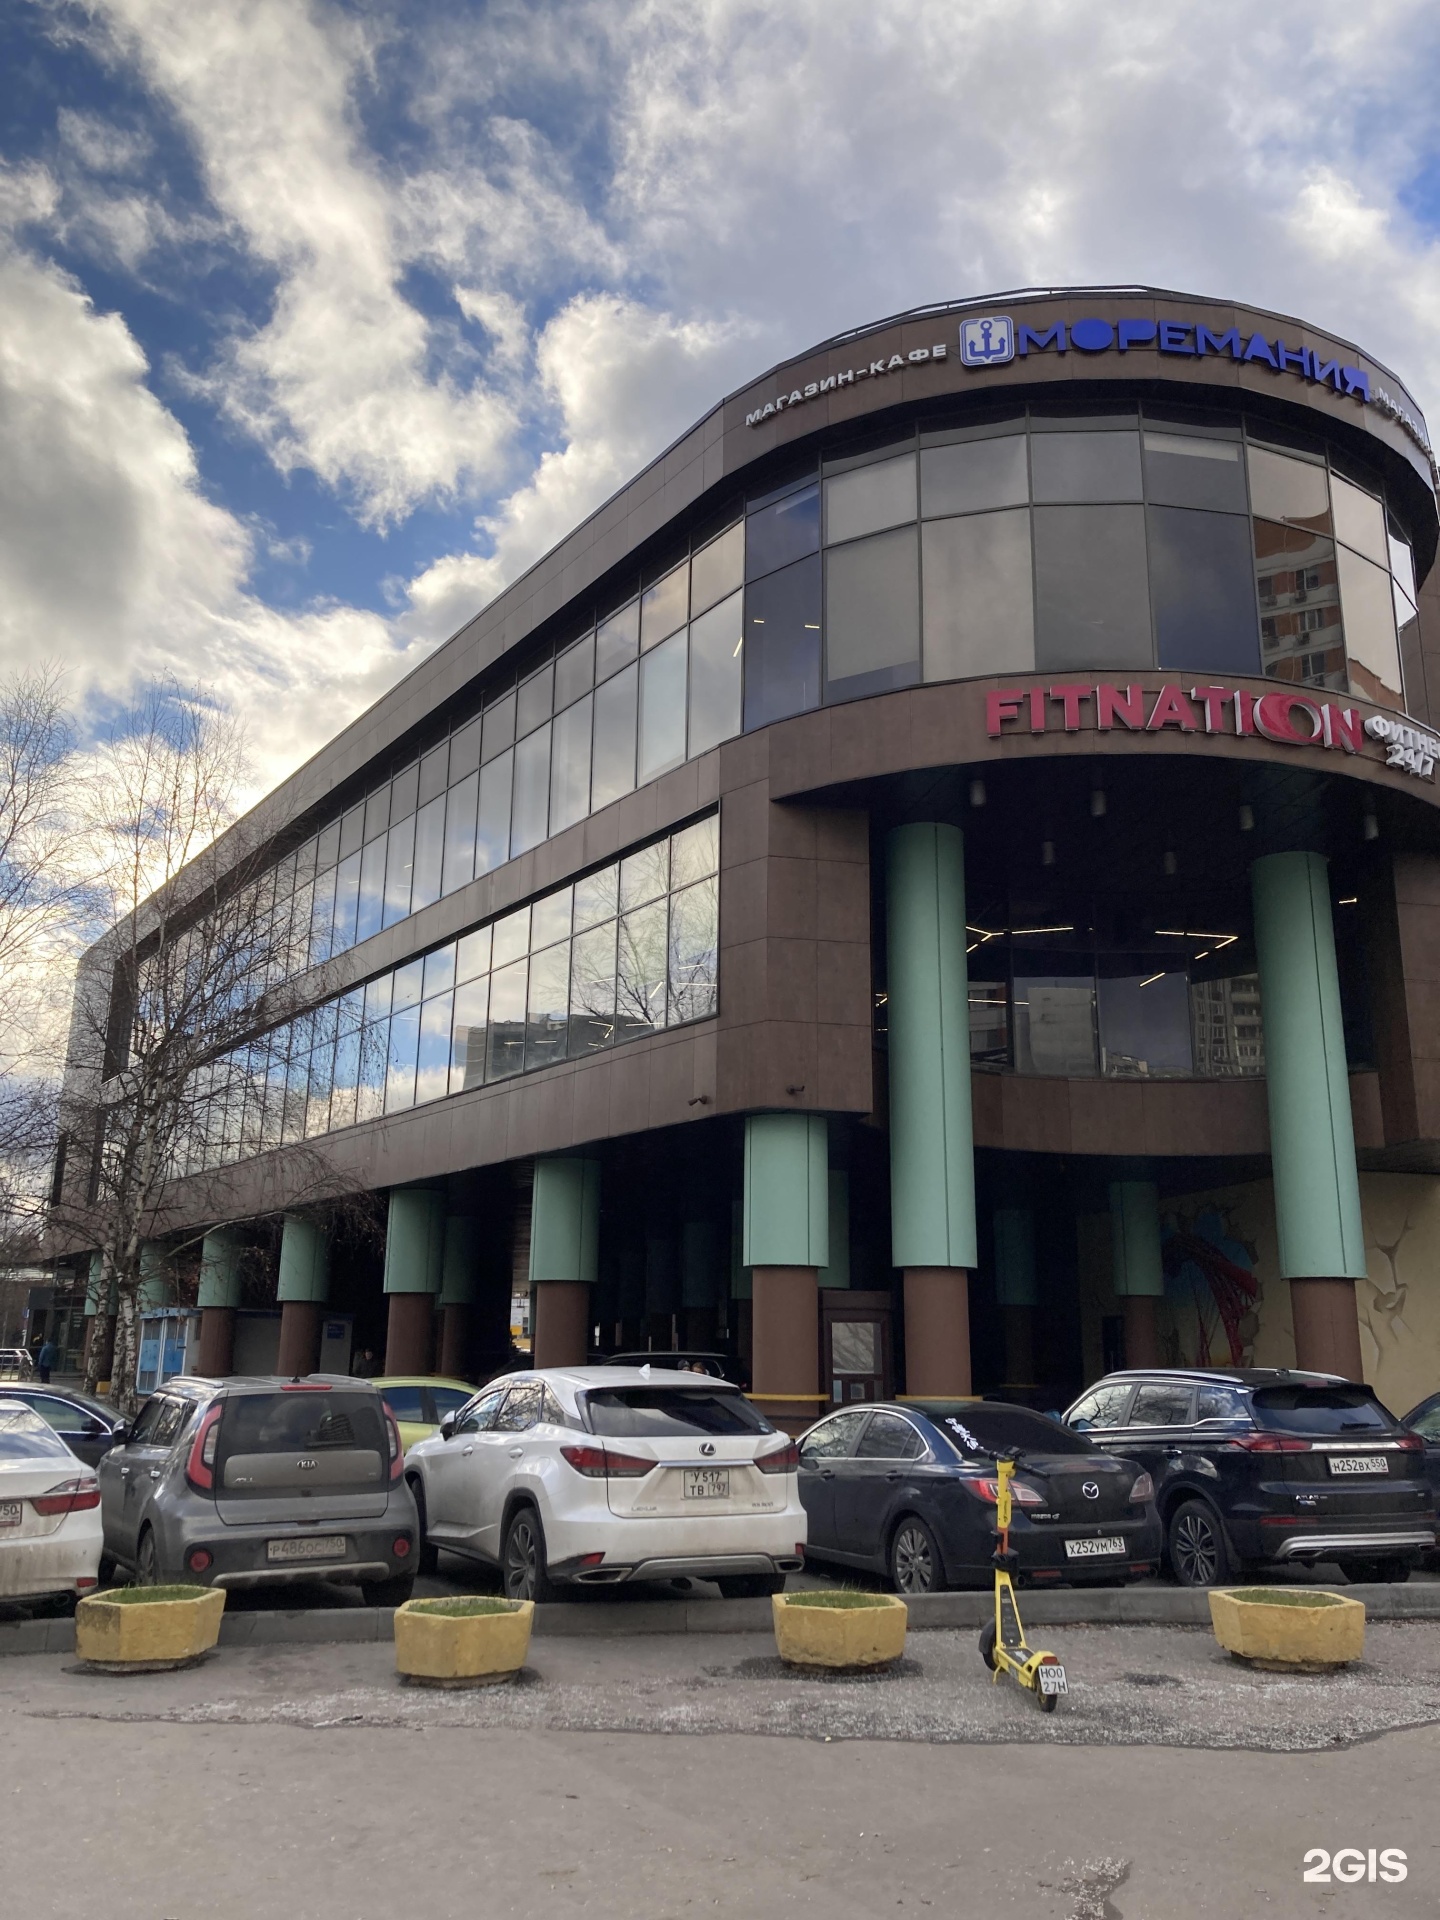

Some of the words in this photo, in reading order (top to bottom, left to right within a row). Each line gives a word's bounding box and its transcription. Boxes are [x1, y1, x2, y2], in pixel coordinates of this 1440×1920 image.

[745, 344, 947, 427] МАГАЗИН-КАФЕ
[1018, 318, 1370, 402] МОРЕМАНИЯ
[986, 684, 1363, 754] FITNATION
[1385, 743, 1435, 777] 24/7
[301, 1460, 316, 1469] KIA
[710, 1483, 726, 1494] 797
